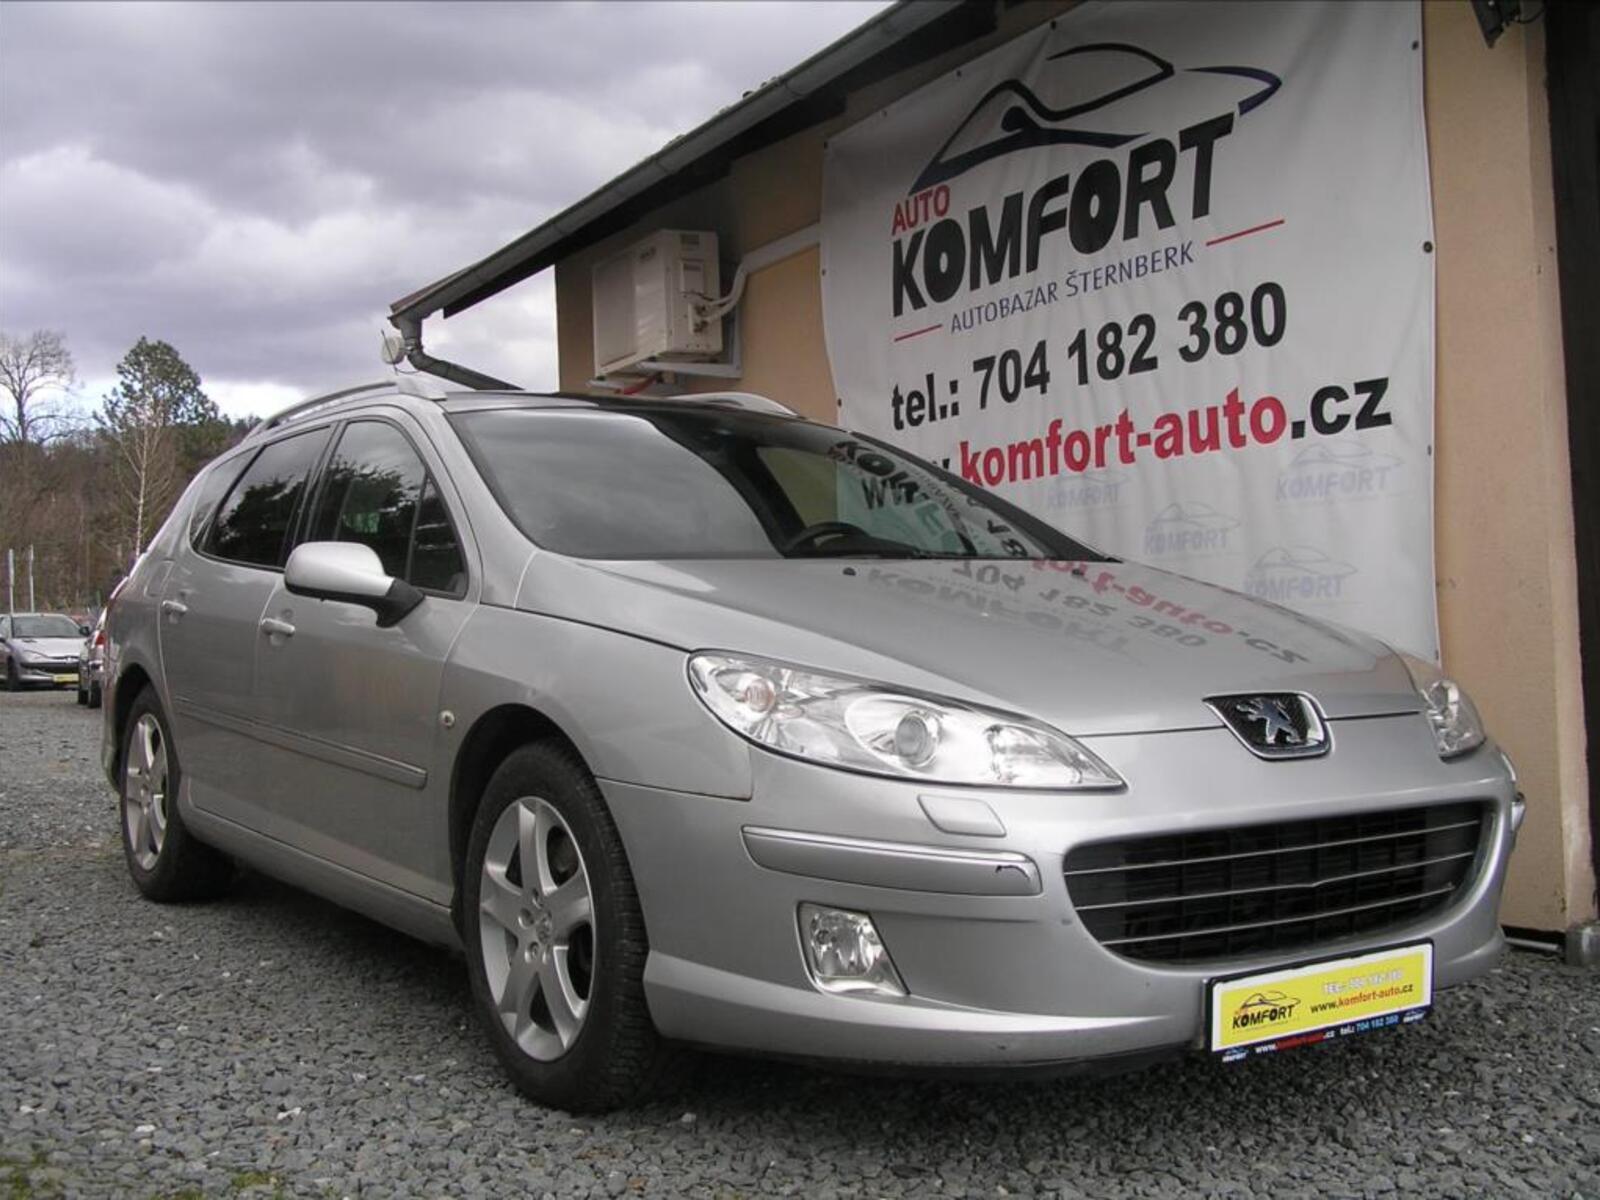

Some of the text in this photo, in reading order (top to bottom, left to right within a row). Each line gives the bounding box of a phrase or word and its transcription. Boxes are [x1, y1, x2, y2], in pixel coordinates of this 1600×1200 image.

[892, 185, 950, 235] AUTO
[892, 112, 1234, 317] KOMFORT
[951, 240, 1194, 334] AUTOBAZAR ŠTERNBERK
[892, 281, 1287, 430] tel.: 704 182 380
[929, 376, 1393, 488] komfort-auto.cz
[1276, 466, 1392, 501] KOMFORT
[1144, 527, 1230, 554] KOMFORT
[1243, 574, 1345, 603] KOMFORT
[1232, 1004, 1295, 1029] KOMFORT
[1310, 983, 1414, 1014] www.komfort-auto.cz
